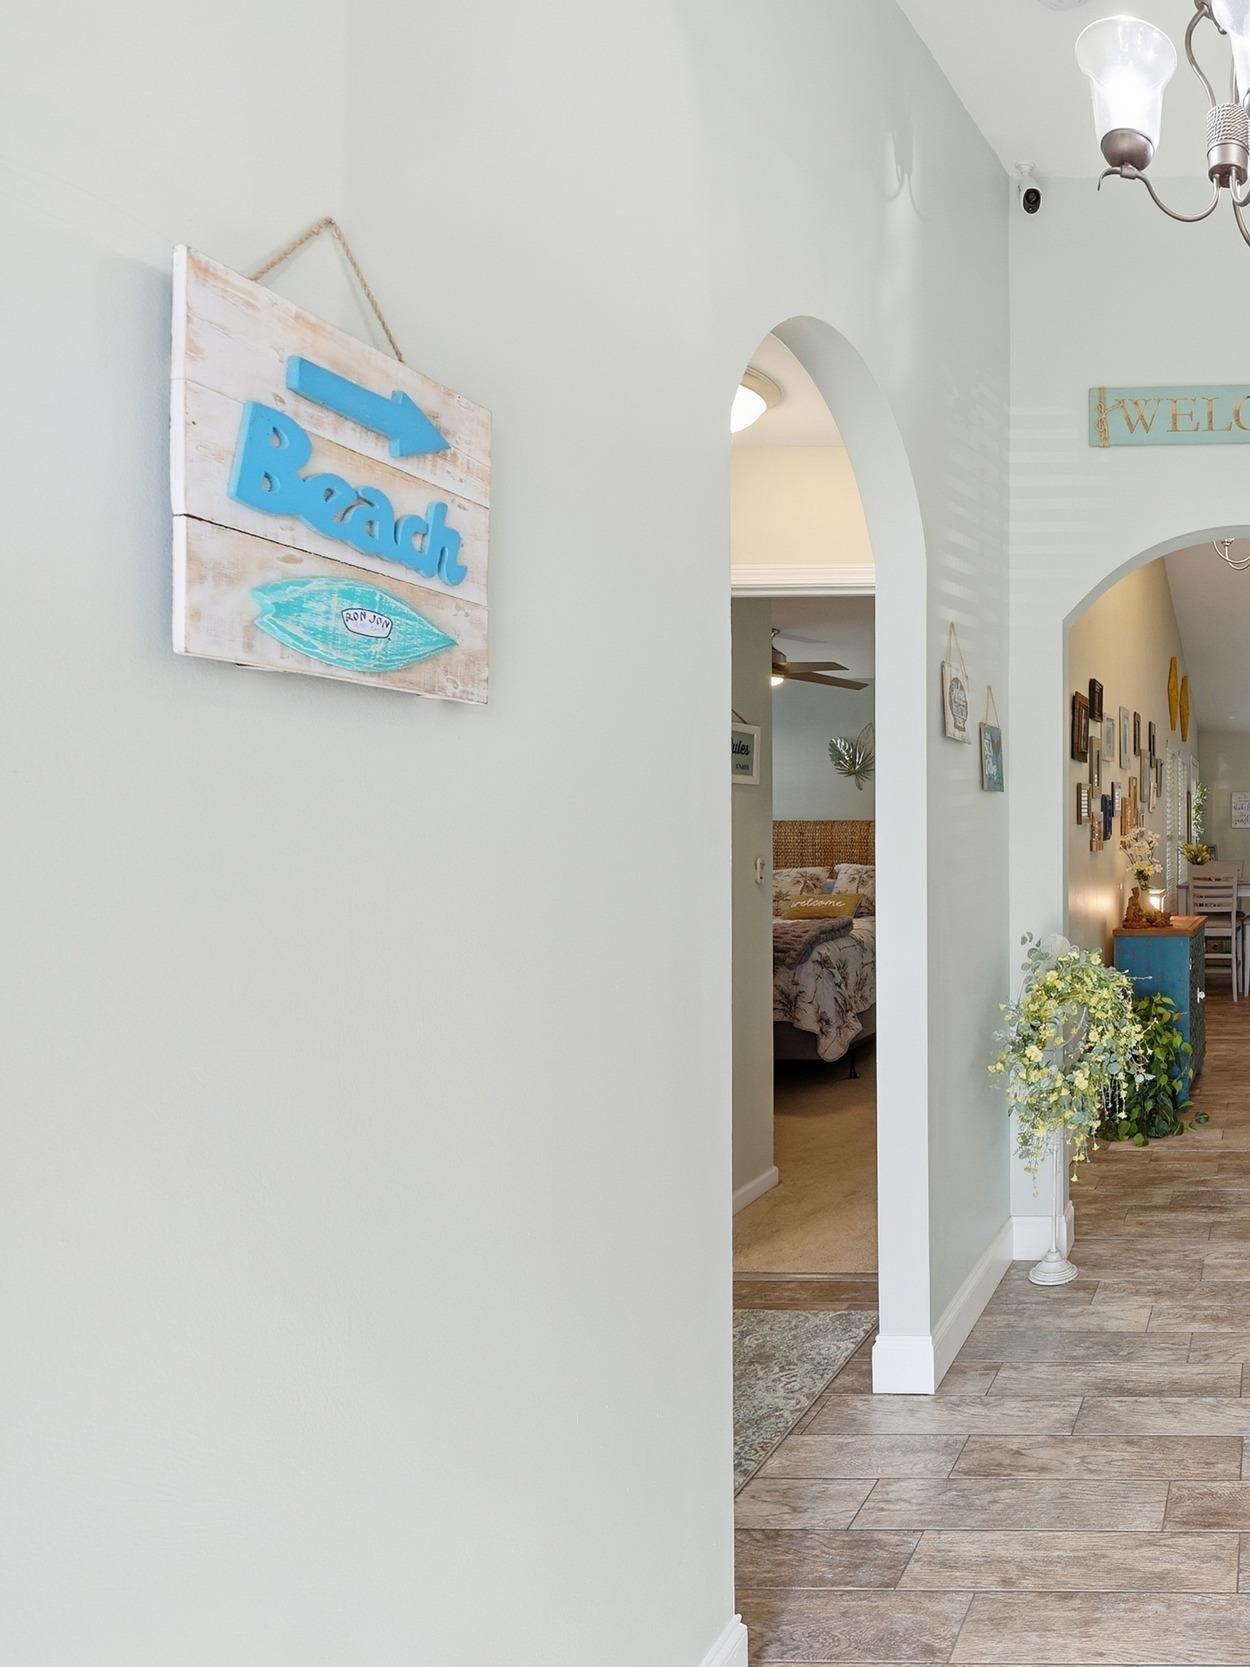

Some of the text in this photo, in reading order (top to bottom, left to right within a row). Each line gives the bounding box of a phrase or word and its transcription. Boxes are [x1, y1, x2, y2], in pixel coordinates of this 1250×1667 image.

[227, 399, 468, 588] Beach
[345, 611, 390, 628] RON JON
[731, 738, 751, 756] ules
[790, 897, 847, 908] welcome
